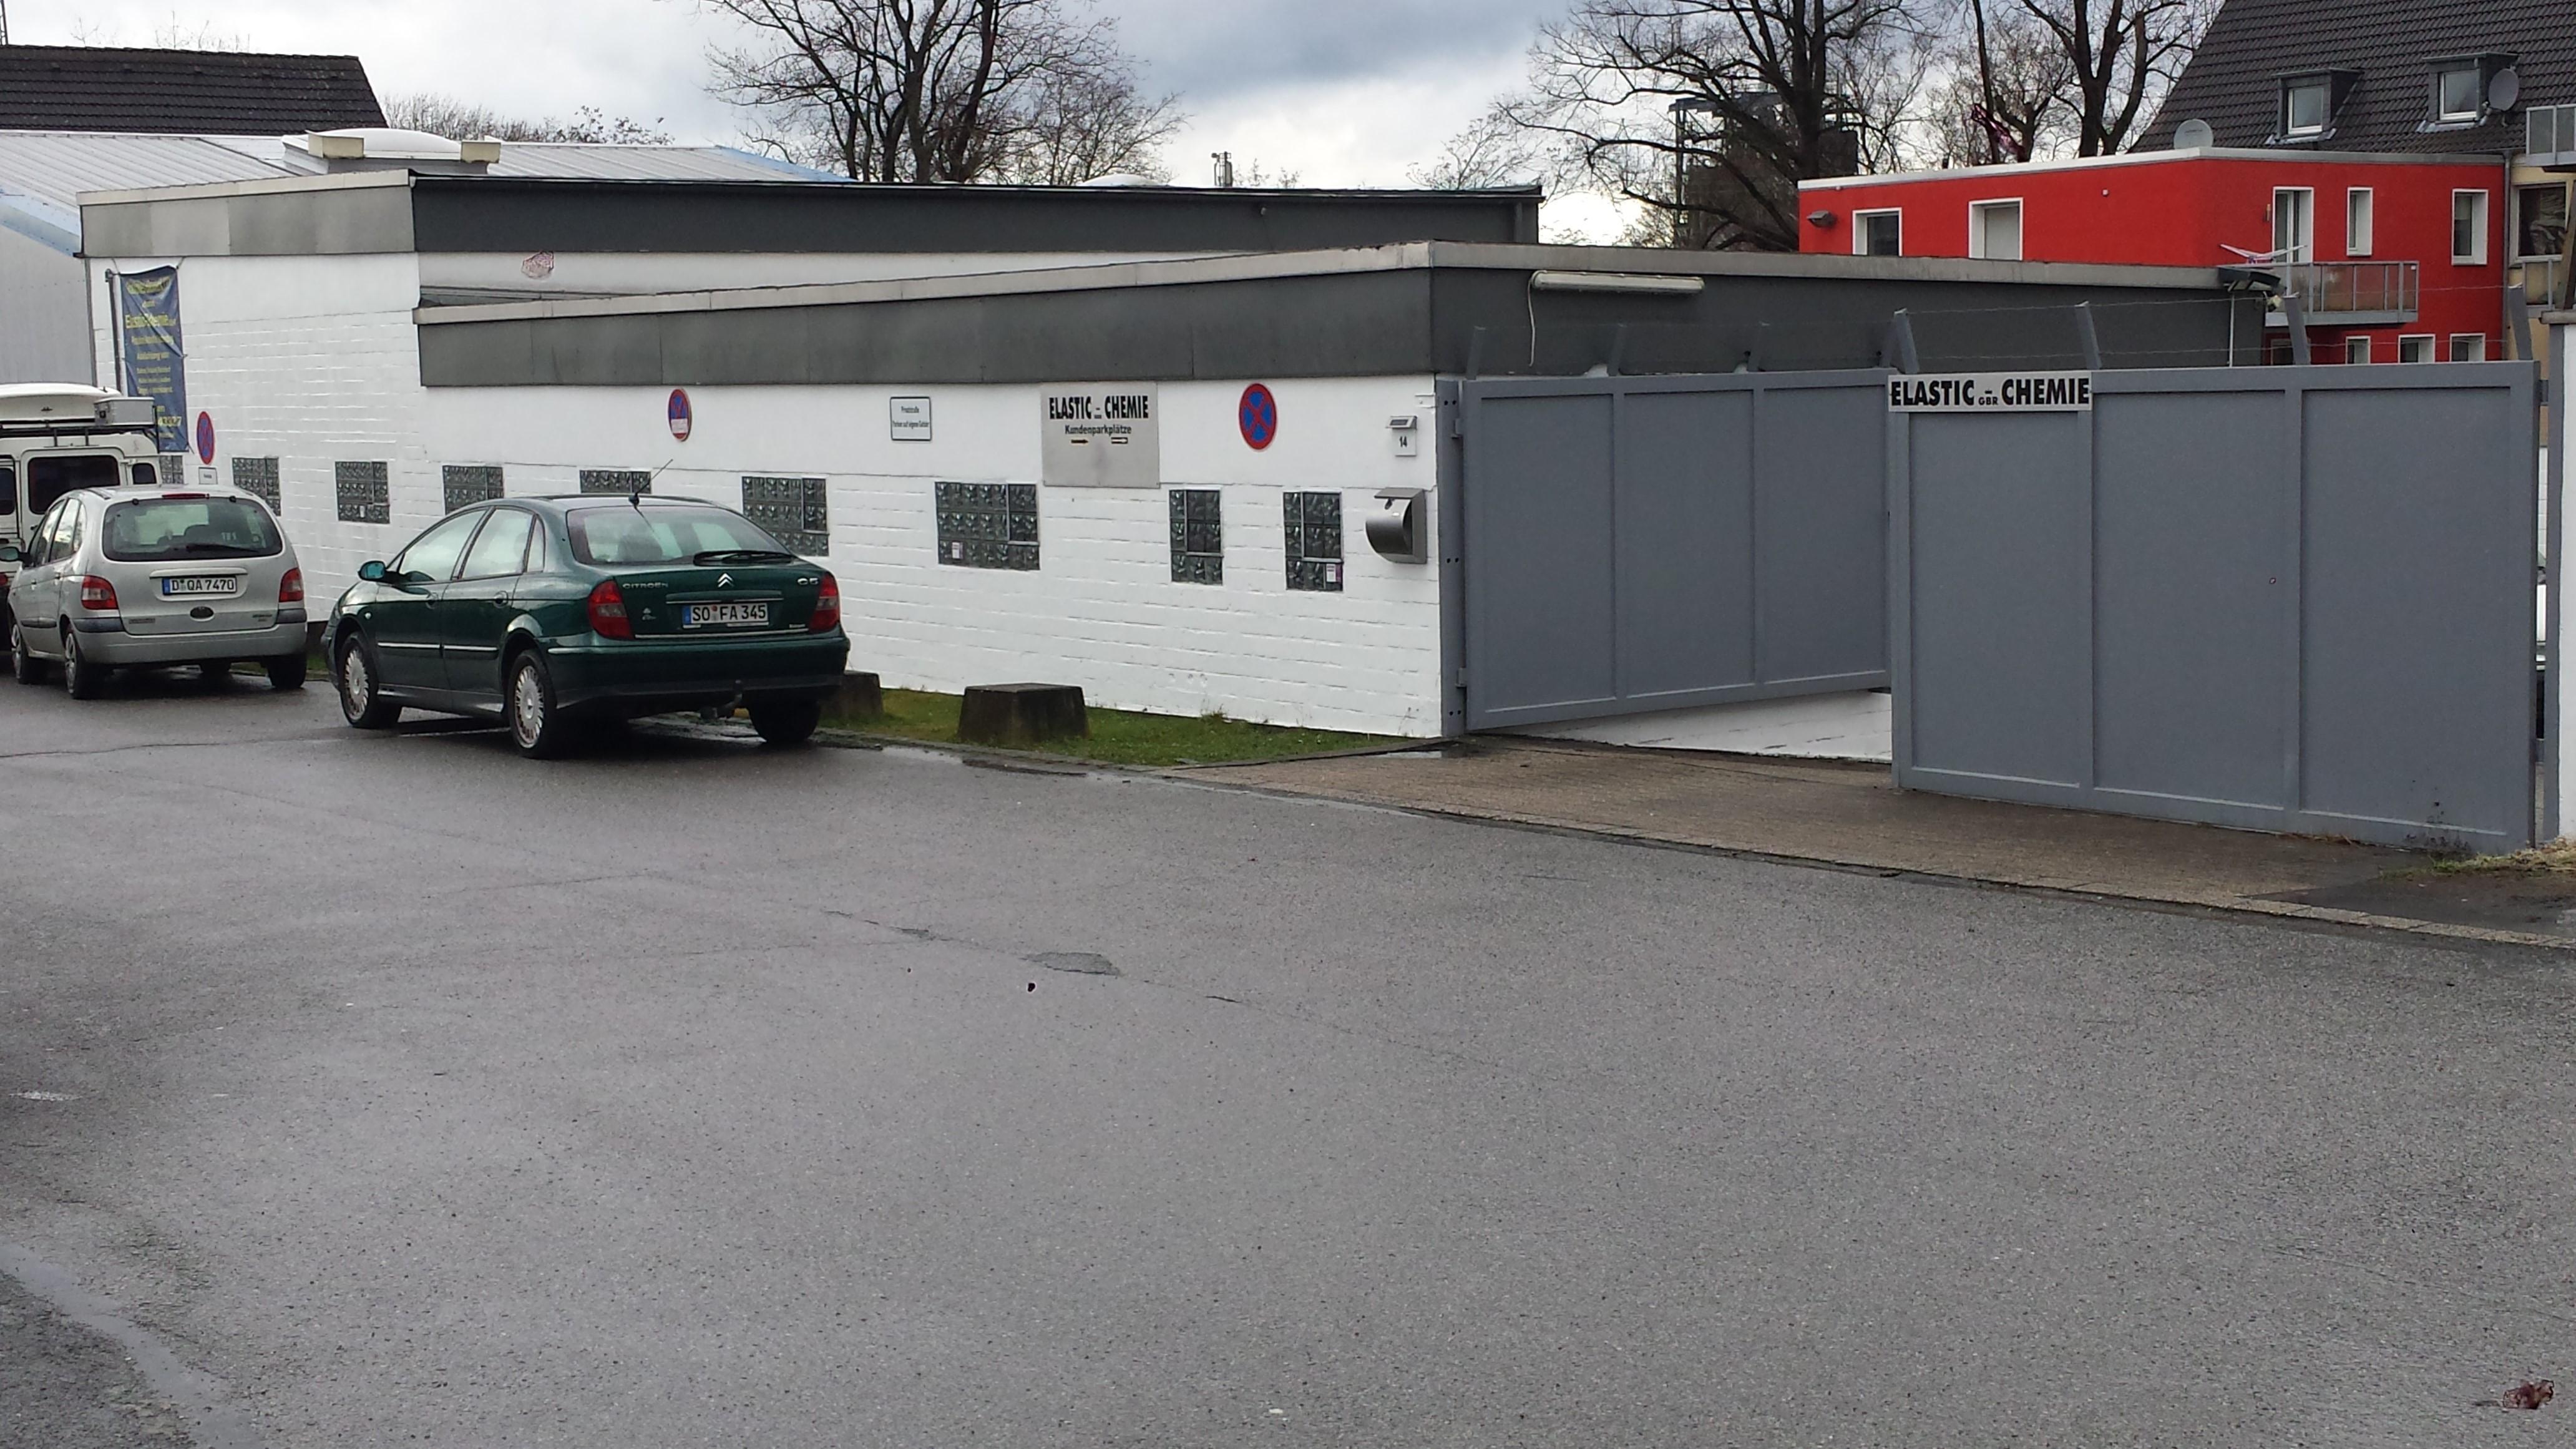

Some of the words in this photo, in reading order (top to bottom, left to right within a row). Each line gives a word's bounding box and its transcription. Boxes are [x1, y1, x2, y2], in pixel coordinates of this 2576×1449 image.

[1891, 379, 1974, 406] ELASTIC
[1978, 396, 1998, 406] GBR
[2001, 378, 2089, 405] CHEMIE
[1049, 396, 1092, 419] ELASTIC
[1105, 395, 1149, 419] CHEMIE
[1065, 424, 1132, 437] Kundenparkplätze
[1399, 436, 1408, 447] 14
[171, 580, 179, 591] D
[187, 579, 203, 591] QA
[206, 579, 234, 591] 7470
[692, 606, 710, 622] SO
[720, 605, 738, 620] FA
[741, 604, 766, 620] 345
